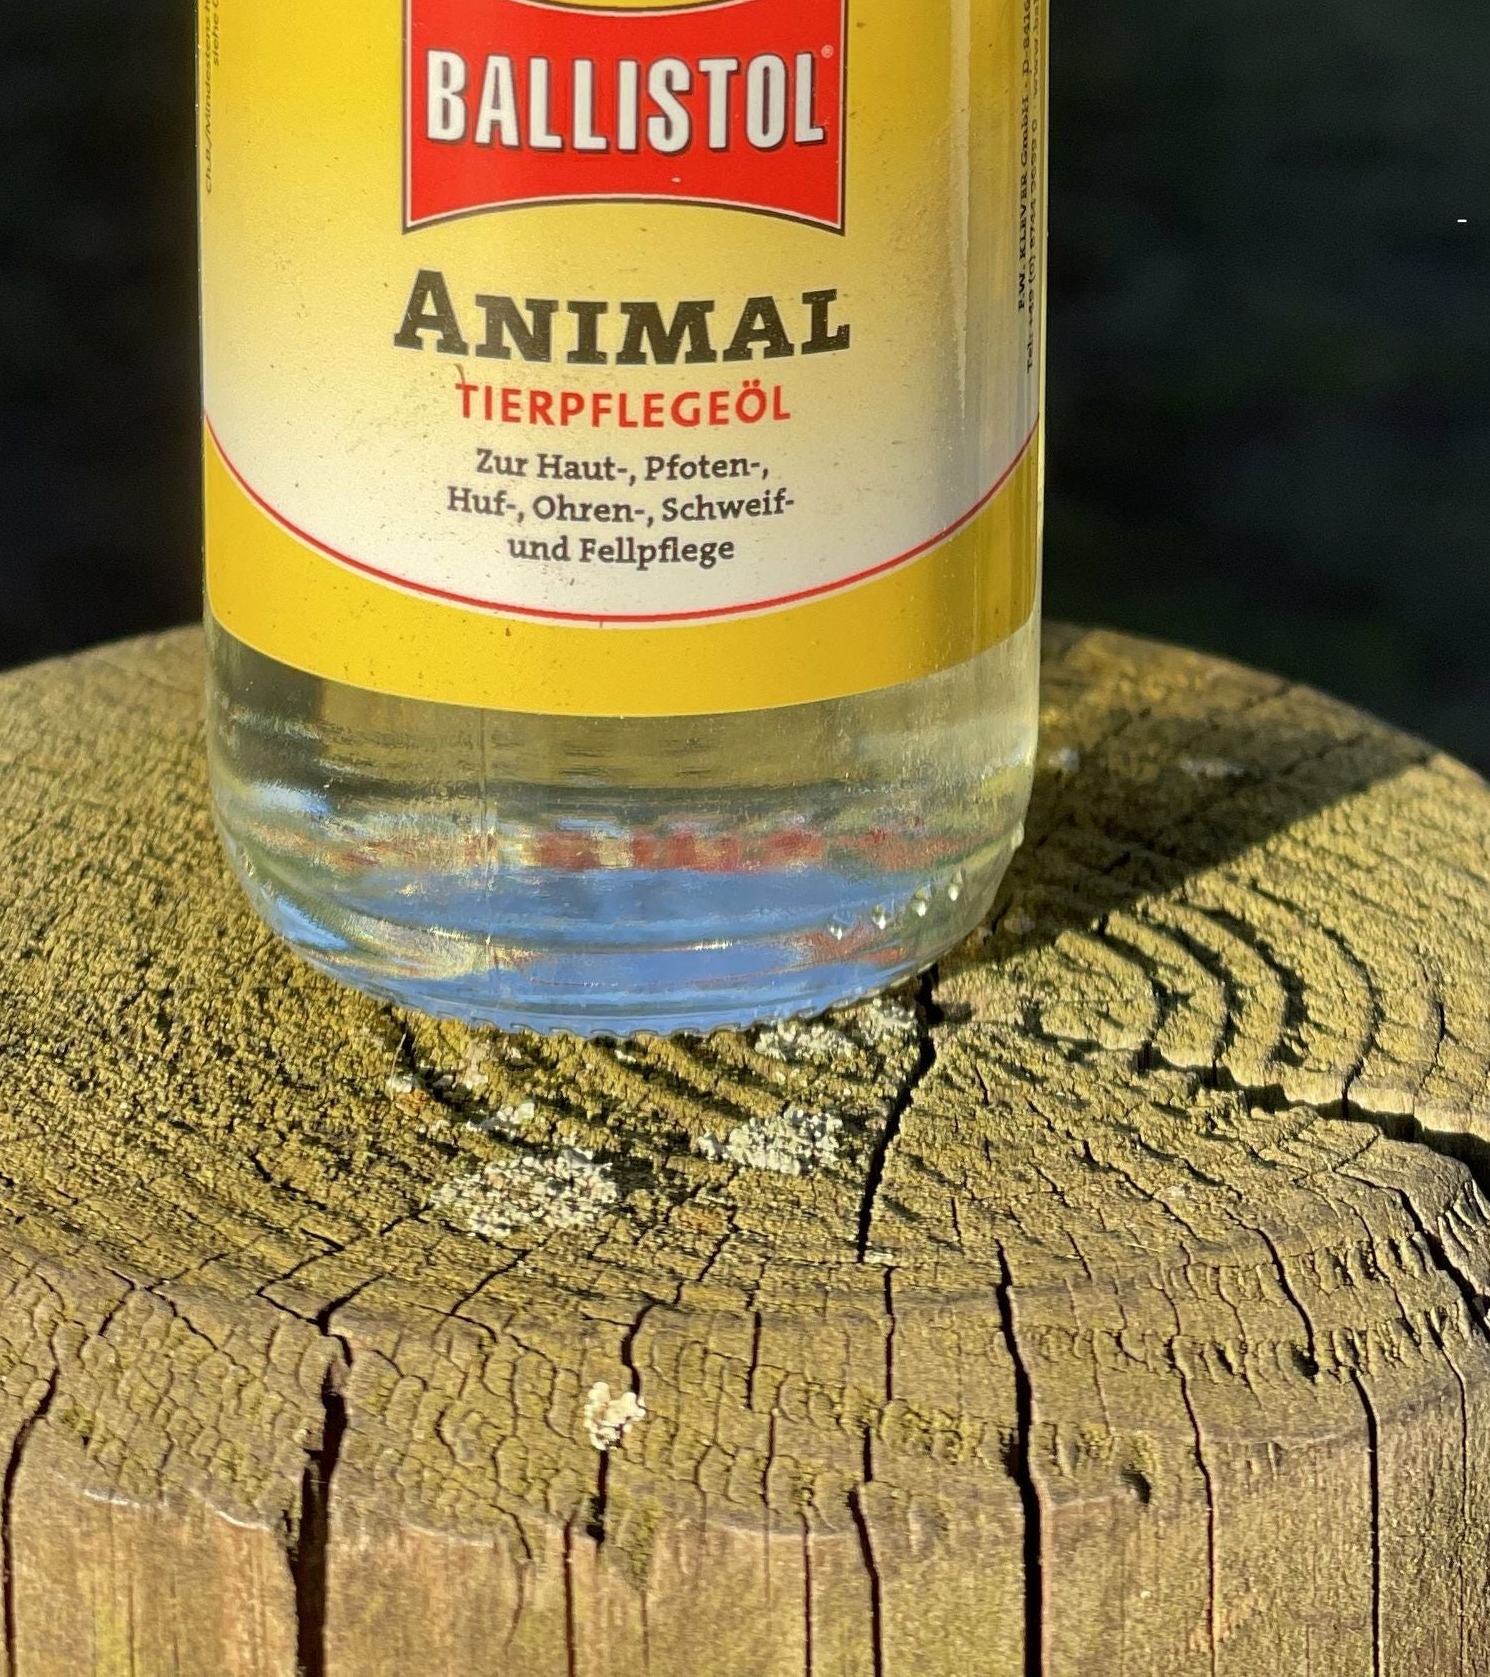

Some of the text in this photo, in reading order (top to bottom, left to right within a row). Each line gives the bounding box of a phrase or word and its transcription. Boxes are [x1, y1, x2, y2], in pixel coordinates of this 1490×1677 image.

[211, 13, 219, 67] siehe
[1021, 96, 1029, 166] GmbH
[1019, 172, 1028, 259] KLEVER
[393, 269, 851, 366] ANIMAL
[454, 378, 792, 428] TIERPFLEGEÖL
[475, 448, 769, 486] Zur Haut-, Pfoten-,
[446, 485, 795, 527] Huf-, Ohren-, Schweif-
[507, 535, 735, 570] und Fellpflege
